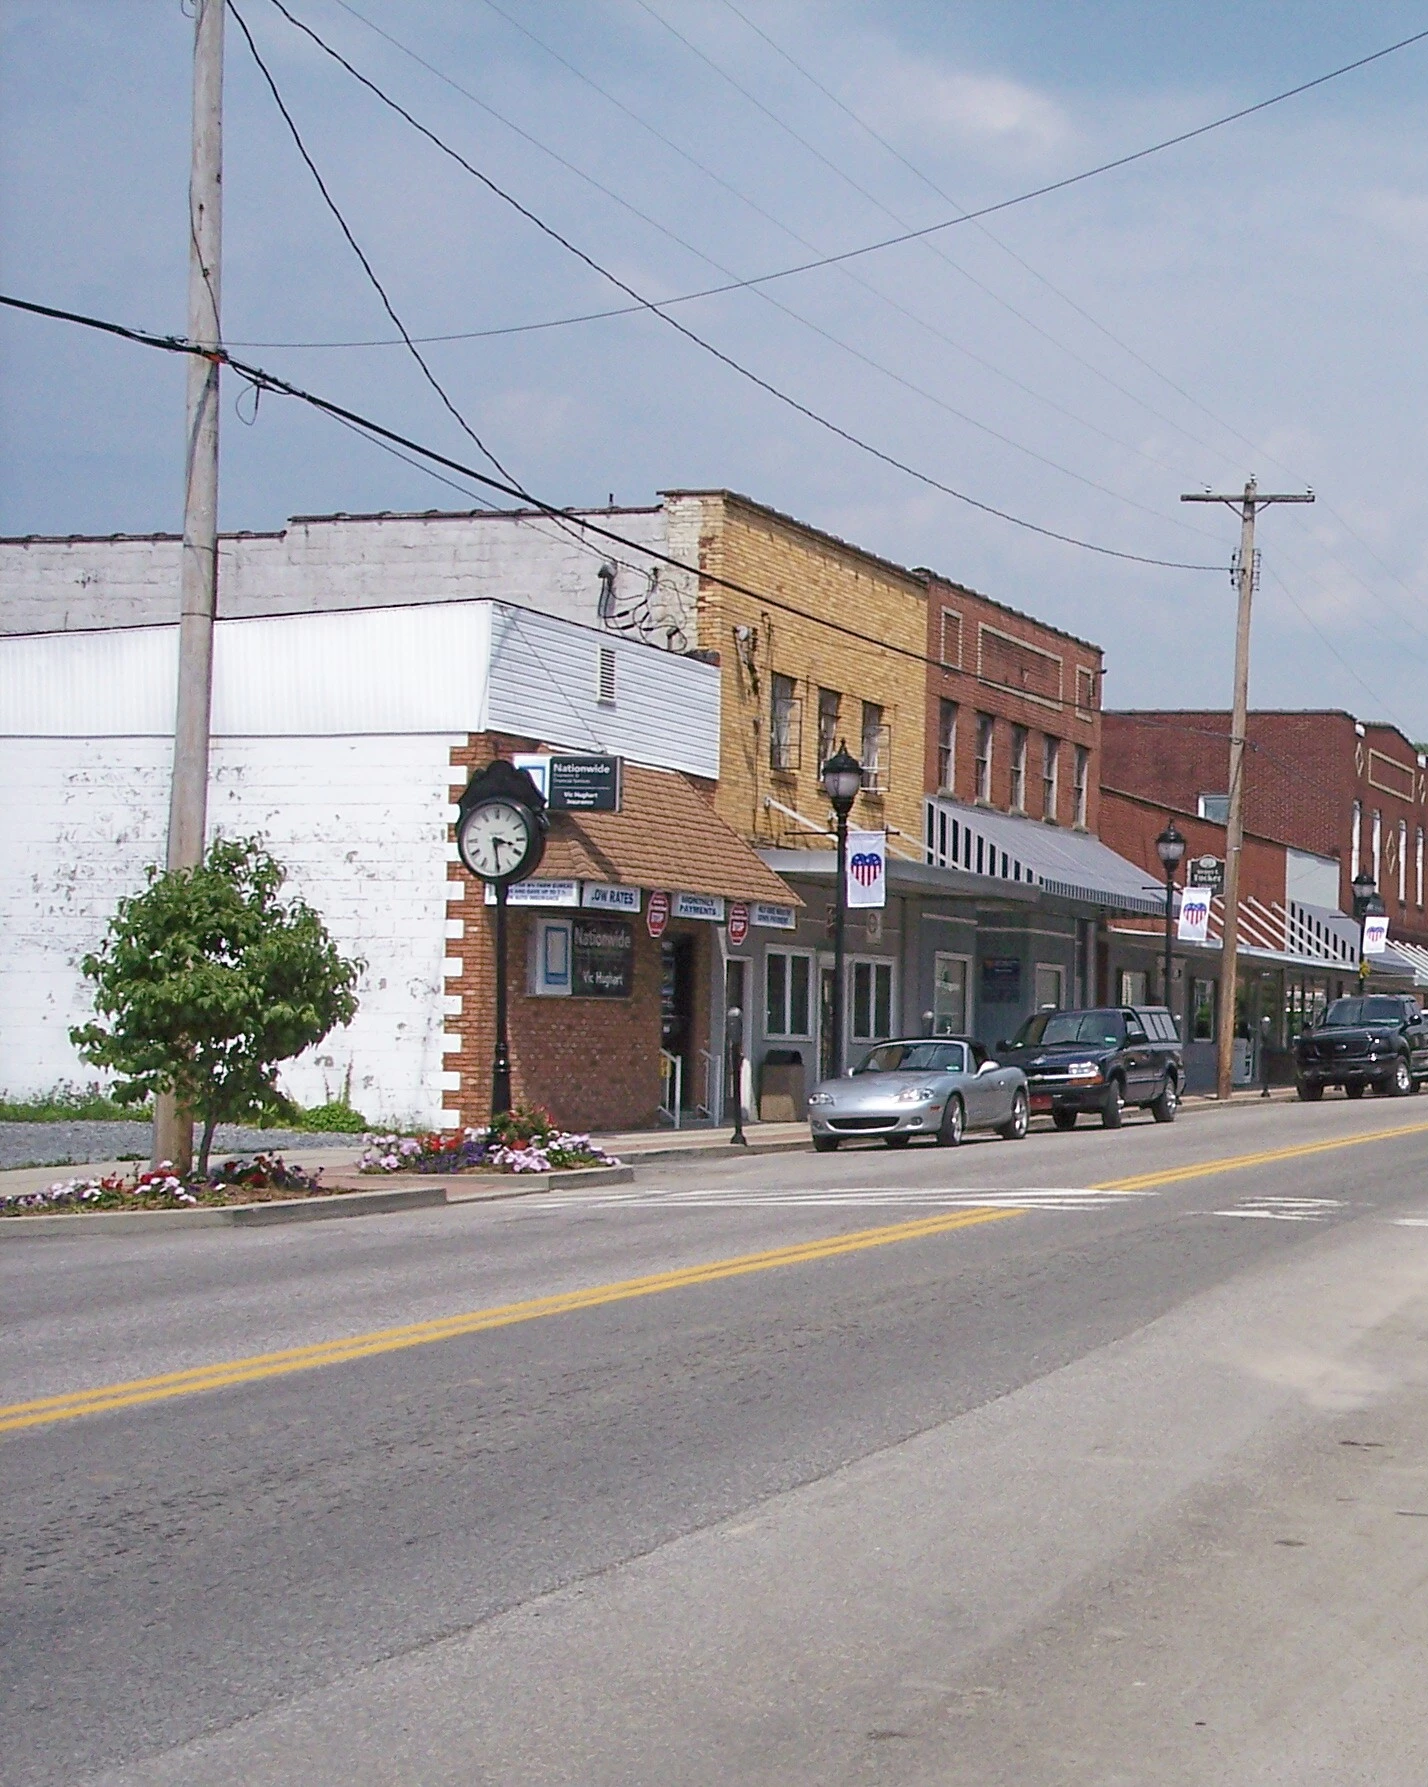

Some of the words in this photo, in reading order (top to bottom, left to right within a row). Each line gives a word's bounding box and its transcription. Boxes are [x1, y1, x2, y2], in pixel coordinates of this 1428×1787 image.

[553, 764, 611, 774] Nationwide
[610, 890, 634, 905] RATES
[680, 905, 716, 916] PAYMENTS
[574, 926, 631, 948] Nationwide
